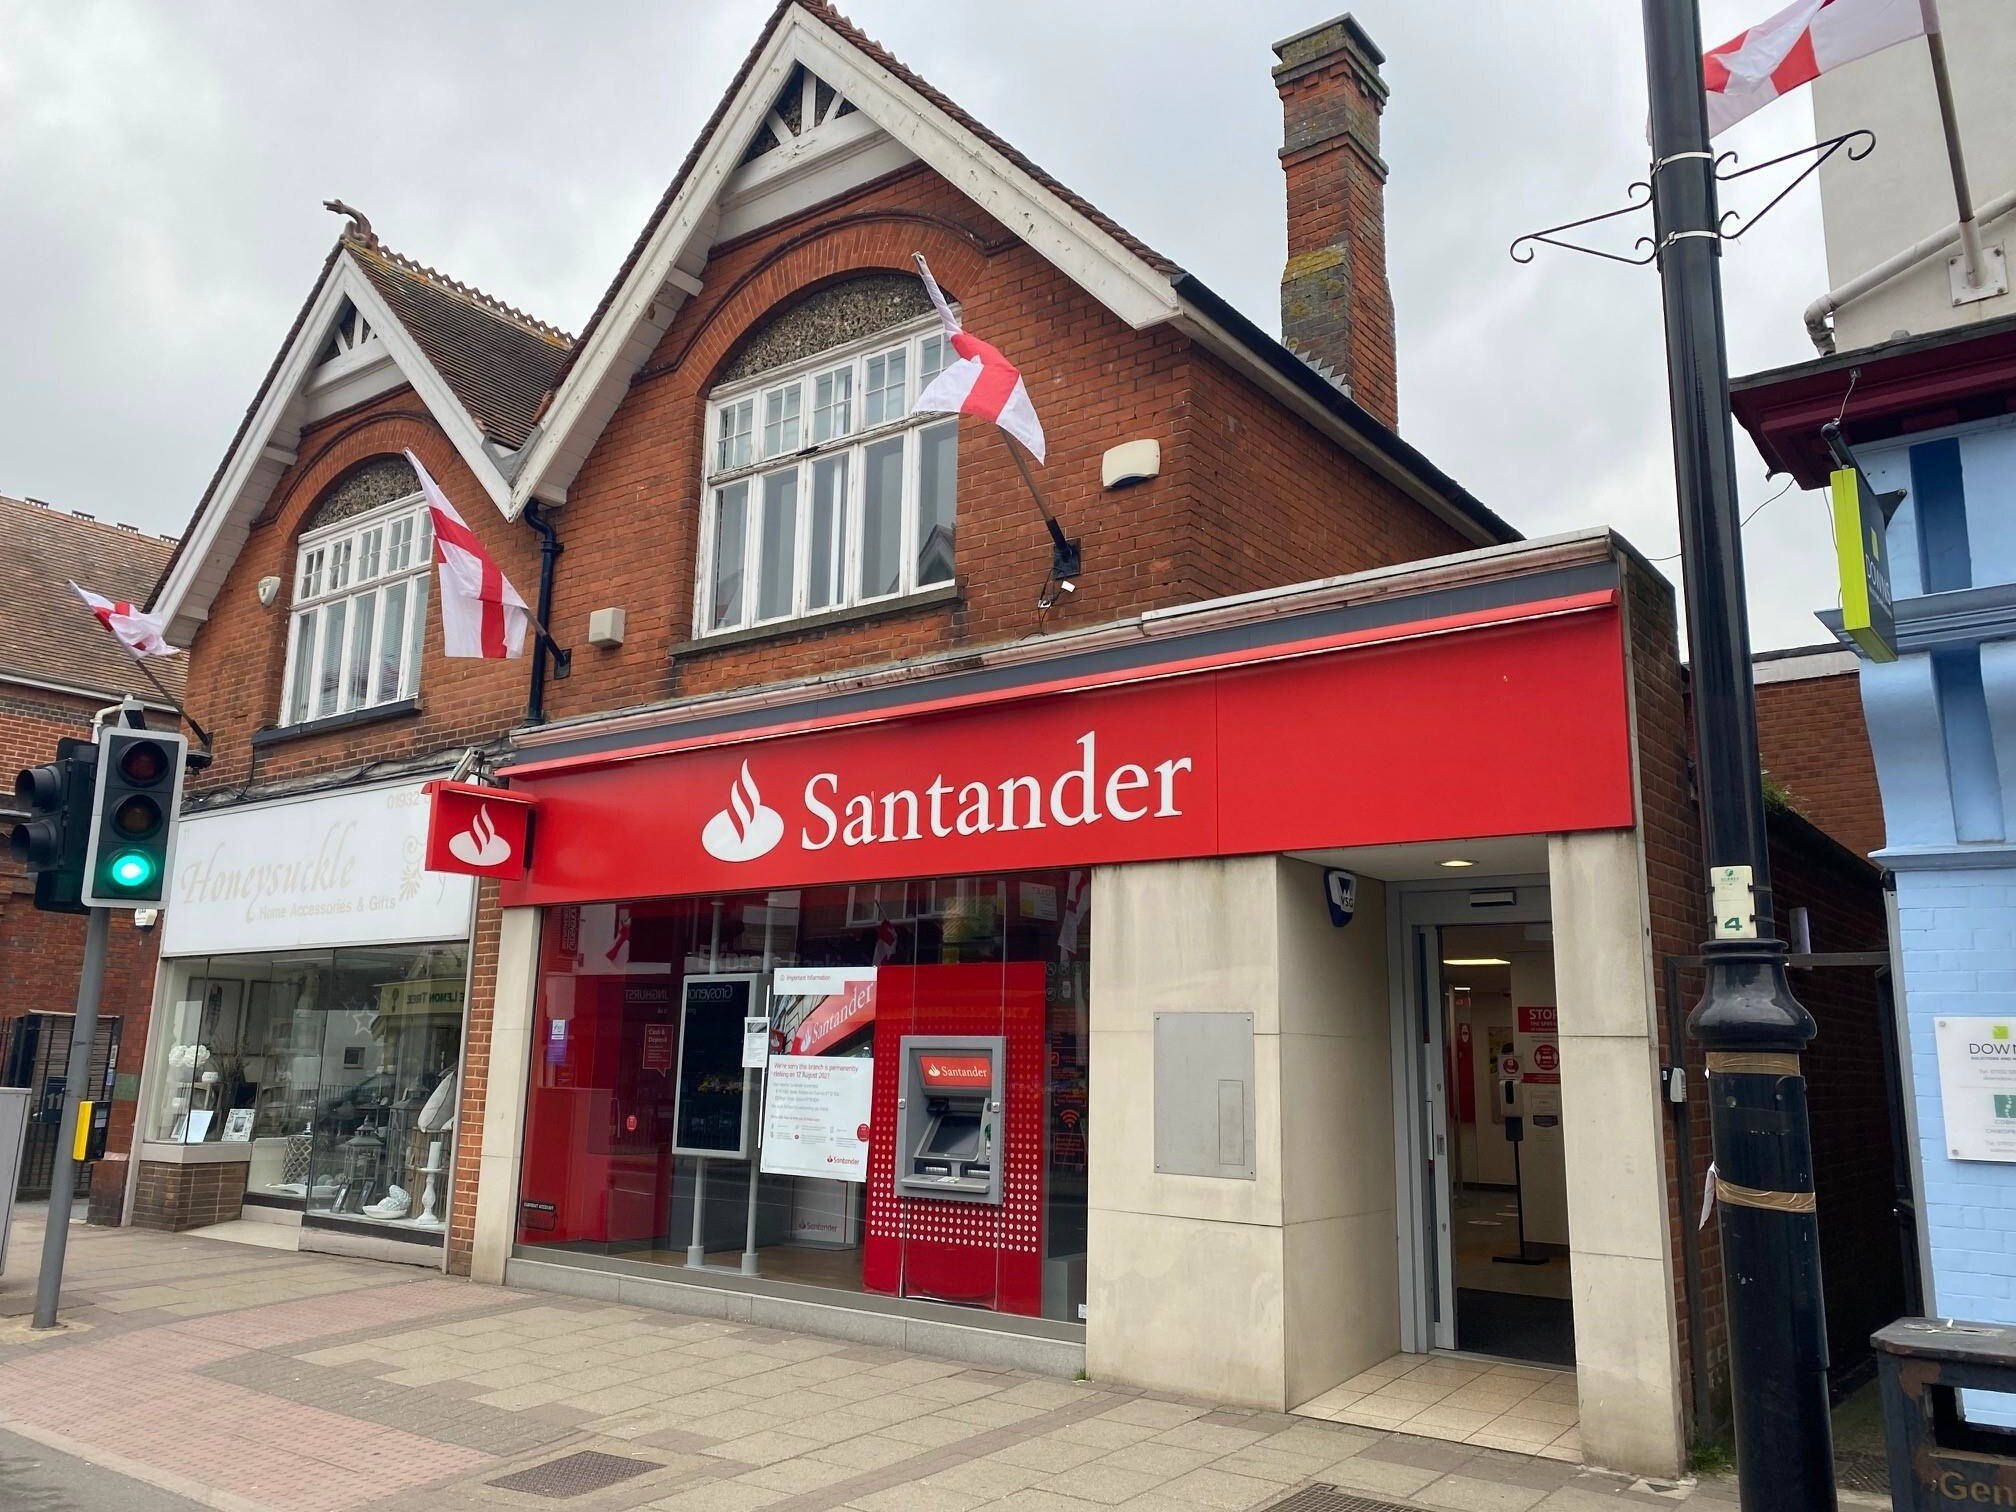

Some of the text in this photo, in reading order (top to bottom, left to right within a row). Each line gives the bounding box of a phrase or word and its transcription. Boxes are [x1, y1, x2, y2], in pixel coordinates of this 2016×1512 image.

[801, 730, 1192, 851] Santander
[180, 819, 358, 924] Honeysuckle
[259, 895, 396, 920] Home Accessories & Gifts
[1724, 917, 1743, 931] 4
[812, 982, 873, 1044] Santander
[941, 1065, 987, 1078] Santander
[833, 1156, 860, 1165] Santander
[806, 1222, 839, 1232] Santander
